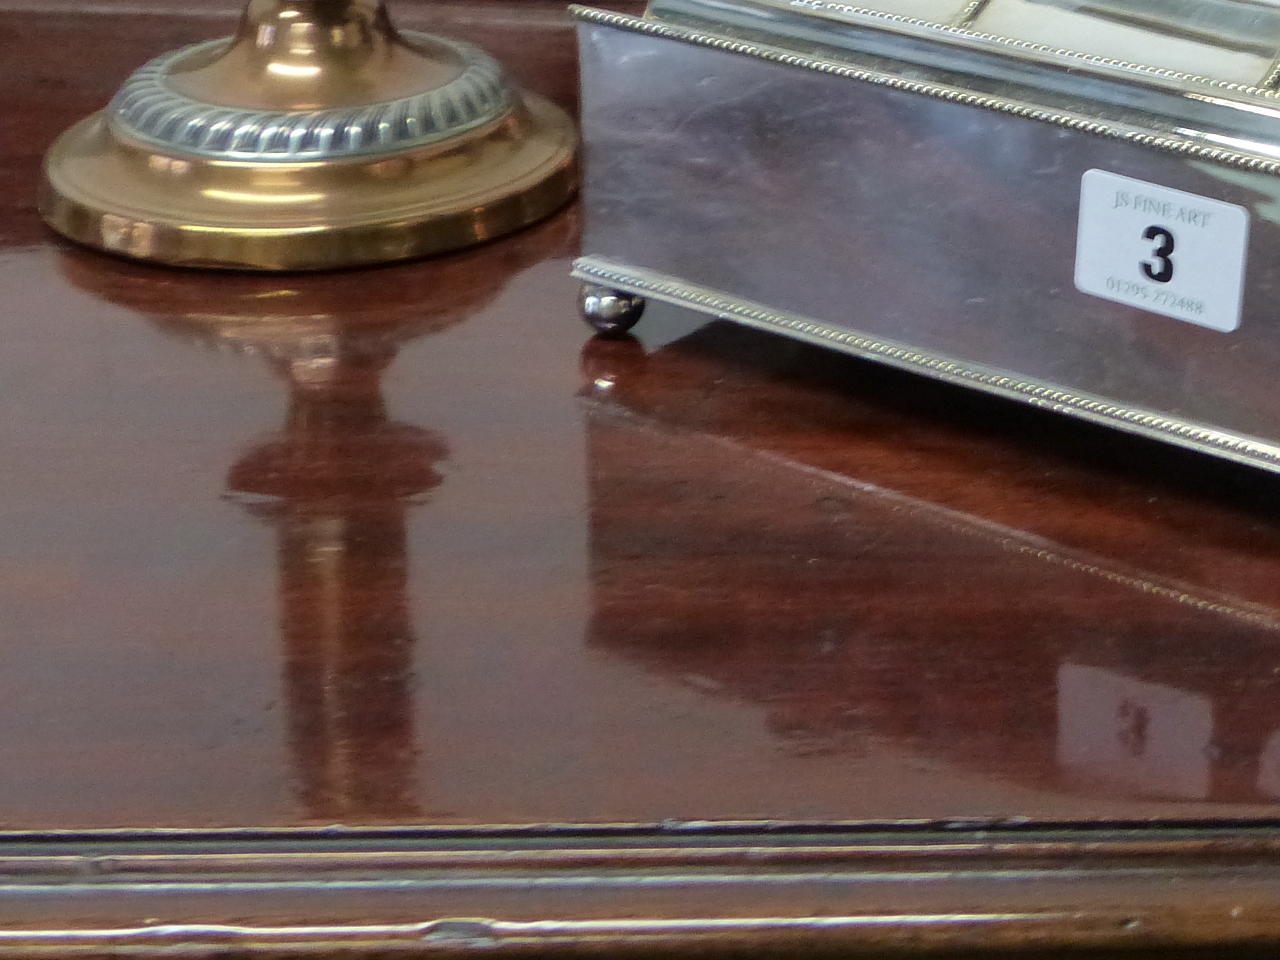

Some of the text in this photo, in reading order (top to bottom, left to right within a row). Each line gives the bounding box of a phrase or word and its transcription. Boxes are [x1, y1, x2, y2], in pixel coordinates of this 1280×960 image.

[1114, 190, 1212, 228] JS FINE ART
[1139, 225, 1175, 284] 3
[1106, 276, 1204, 316] 01295 272488
